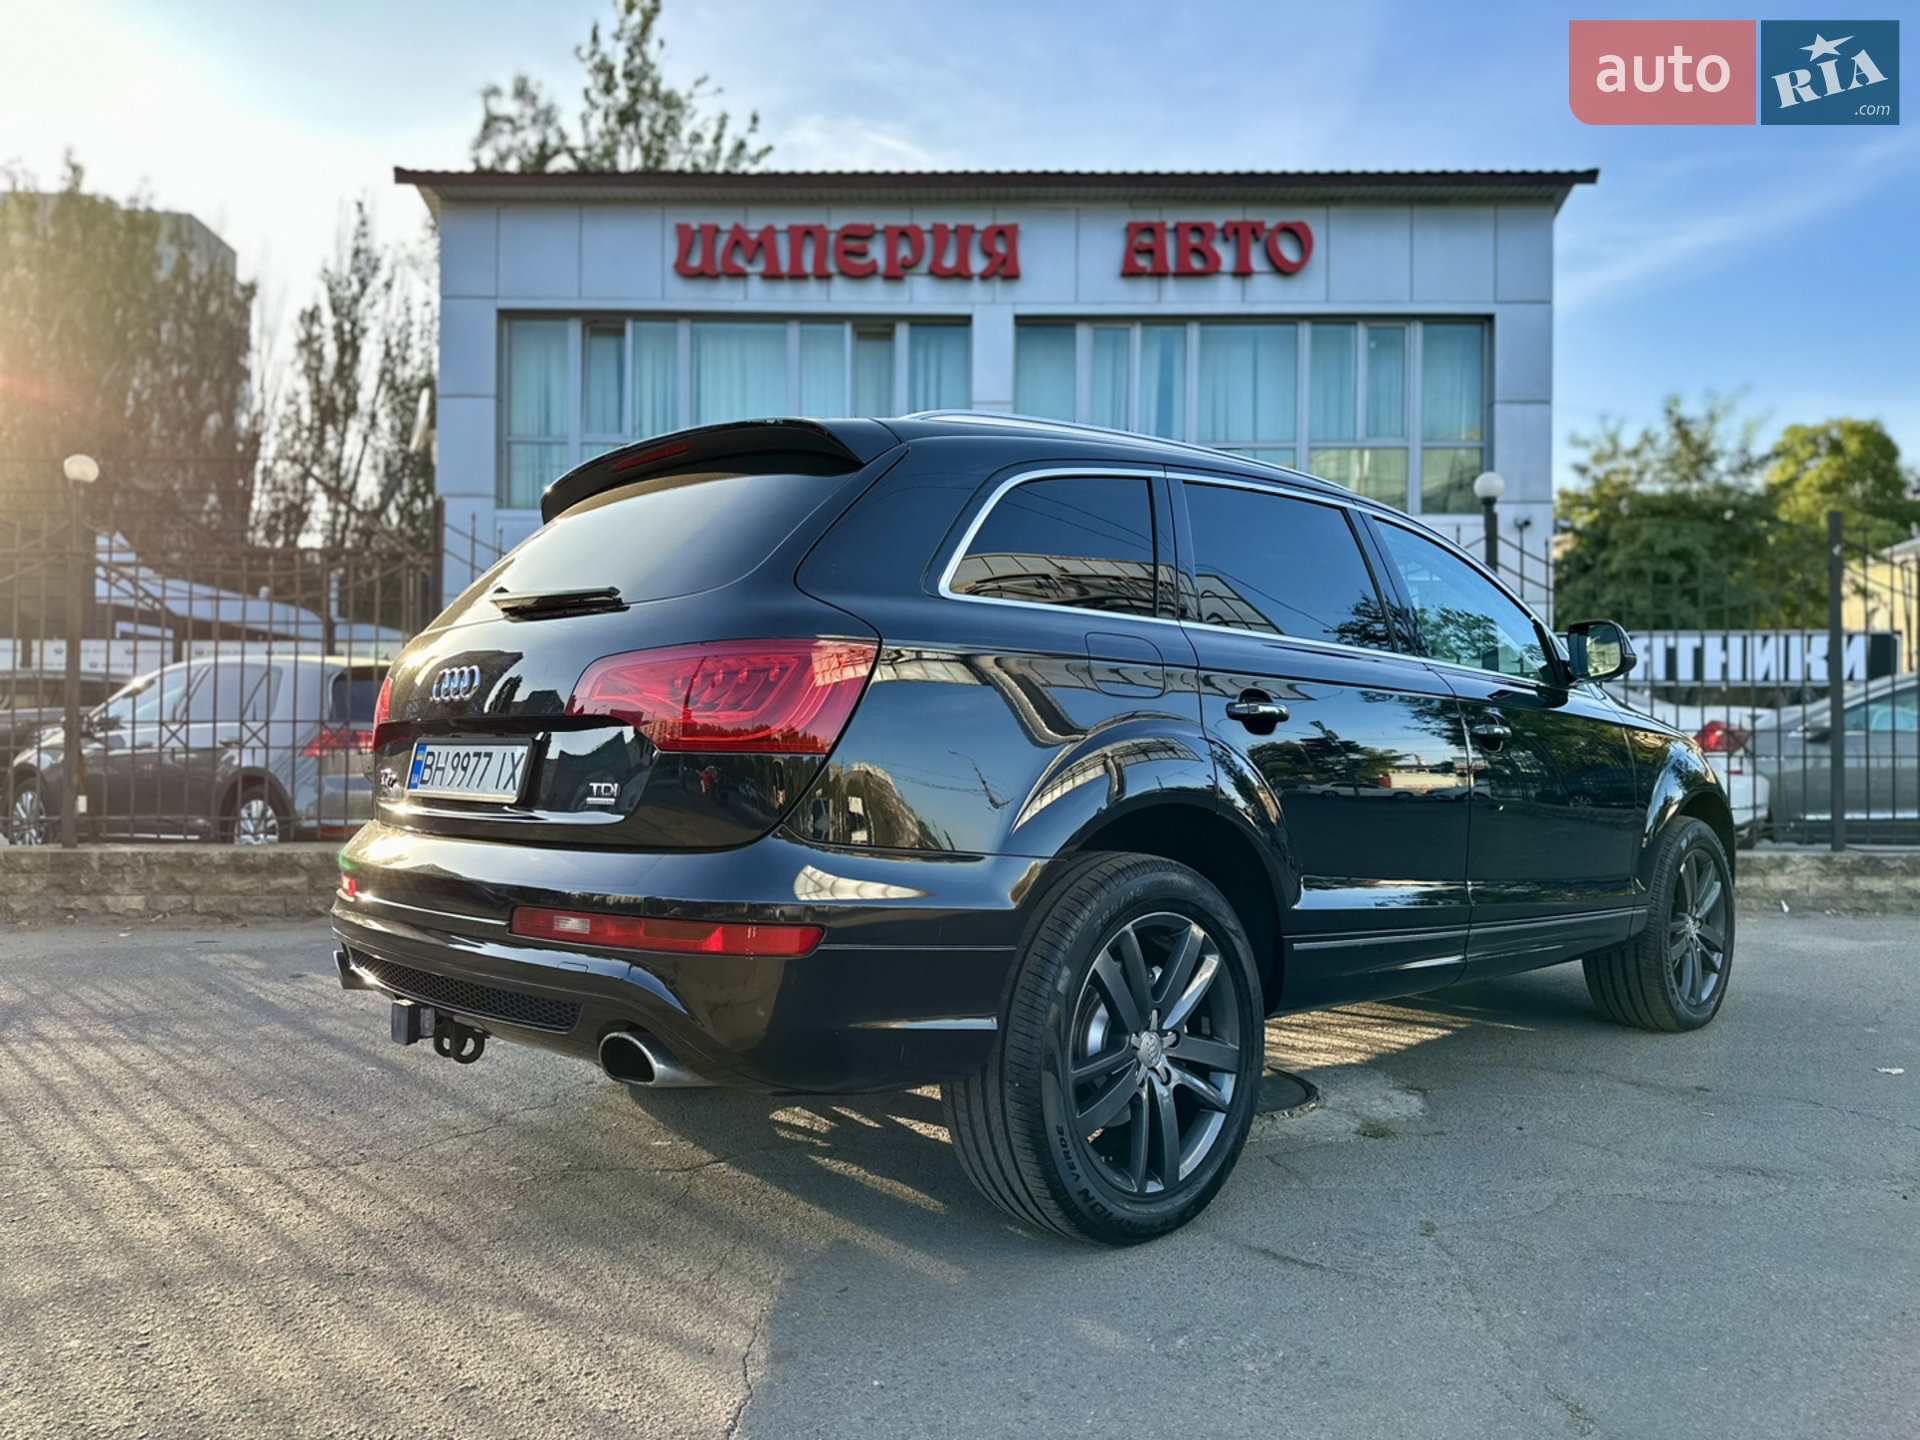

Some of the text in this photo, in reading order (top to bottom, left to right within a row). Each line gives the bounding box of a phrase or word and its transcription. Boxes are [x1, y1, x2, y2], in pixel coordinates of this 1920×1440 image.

[673, 220, 1313, 280] ИМПЕРИЯ АВТО
[1617, 634, 1867, 681] ЯТНИКИ
[588, 781, 619, 797] TDI
[1055, 1124, 1082, 1183] VERDE
